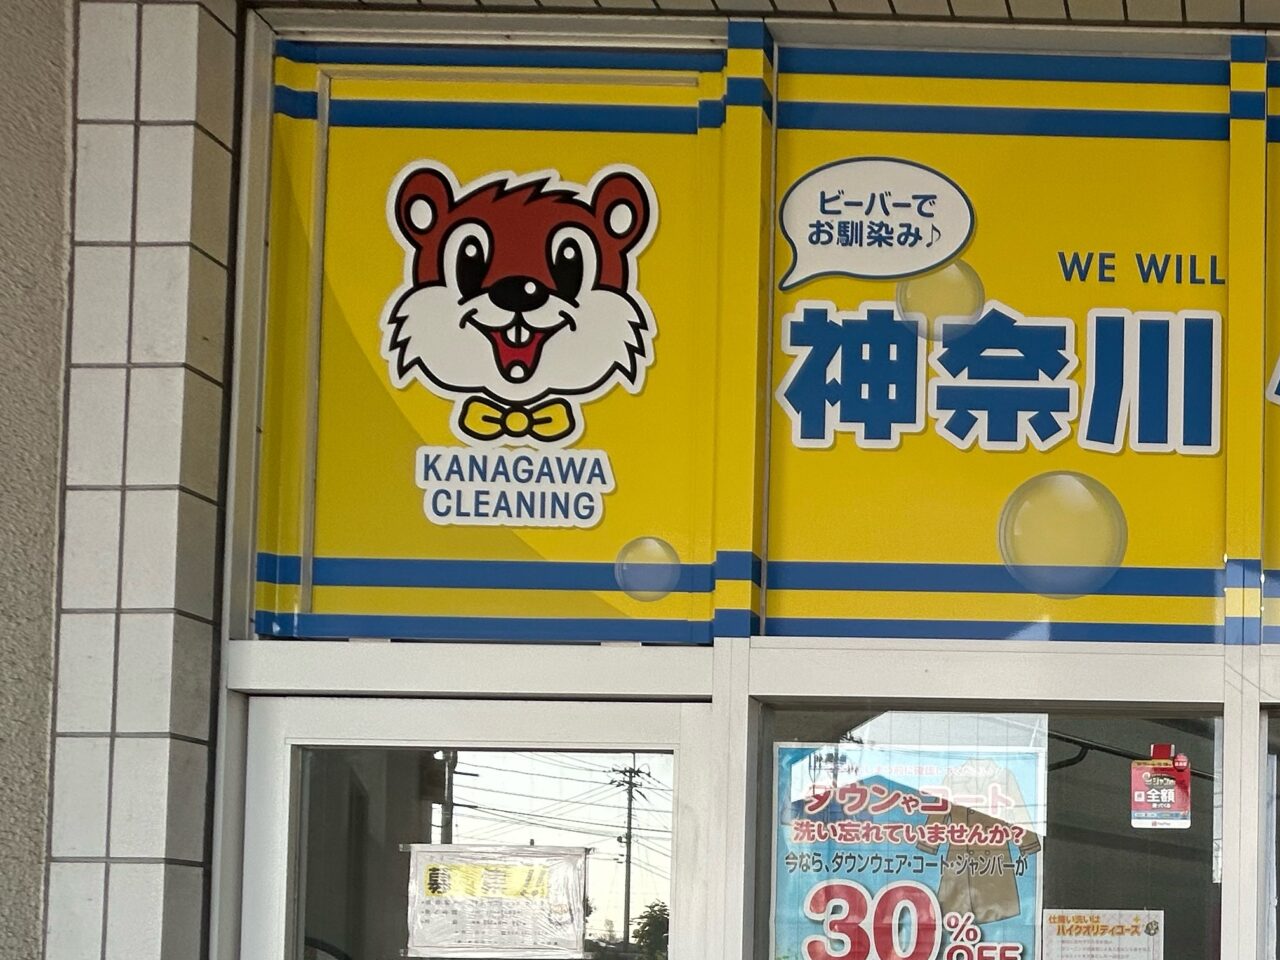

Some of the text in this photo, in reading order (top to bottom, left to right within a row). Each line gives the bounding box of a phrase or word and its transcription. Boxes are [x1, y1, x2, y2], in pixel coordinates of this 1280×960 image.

[819, 189, 938, 218] ビーバーで
[1057, 251, 1117, 283] WE
[1135, 253, 1227, 286] WILL
[781, 304, 1219, 451] 神奈川
[423, 453, 607, 485] KANAGAWA
[431, 488, 595, 520] CLEANING
[793, 819, 1026, 846] 洗い忘れていませんか?
